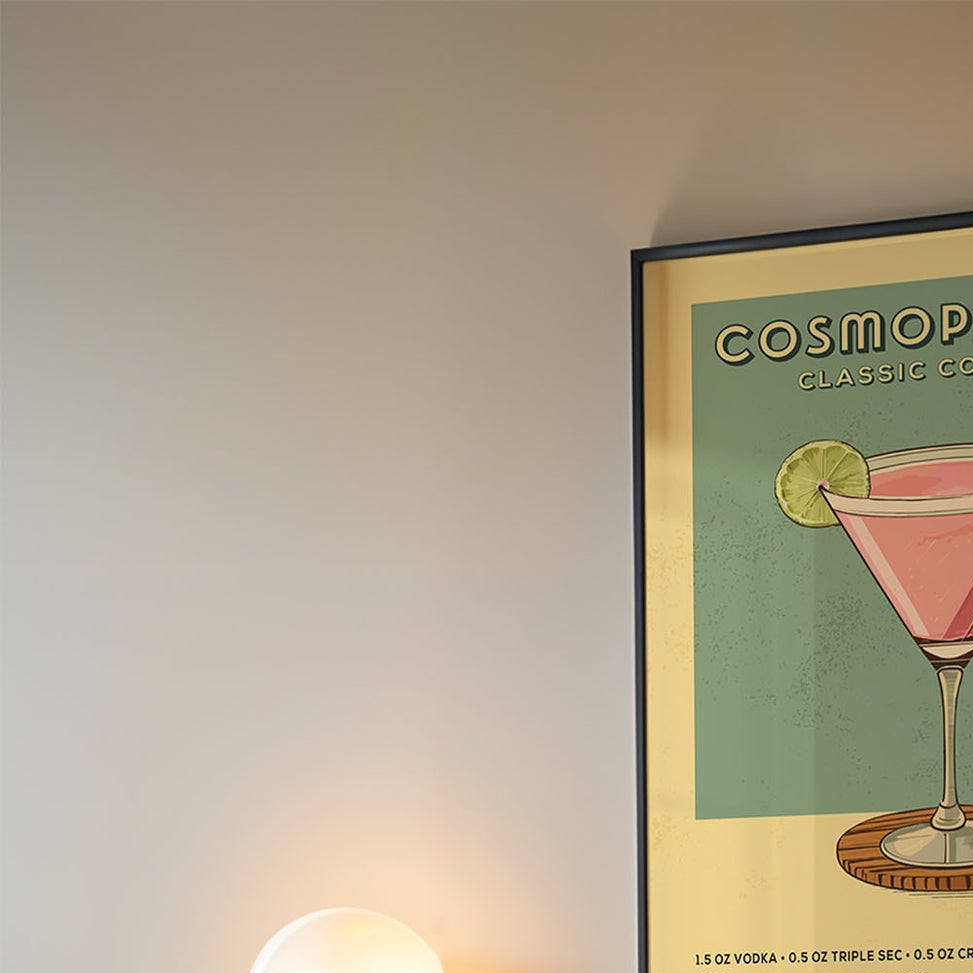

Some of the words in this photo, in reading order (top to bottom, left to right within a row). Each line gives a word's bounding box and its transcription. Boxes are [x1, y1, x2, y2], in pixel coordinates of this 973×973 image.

[798, 360, 927, 391] CLASSIC
[695, 953, 711, 965] 1.5
[715, 953, 731, 965] OZ
[734, 952, 777, 965] VODKA
[789, 951, 808, 963] 0.5
[811, 951, 828, 963] OZ
[831, 950, 874, 962] TRIPLE
[878, 949, 902, 961] SEC
[914, 948, 934, 960] 0.5
[937, 948, 954, 960] OZ
